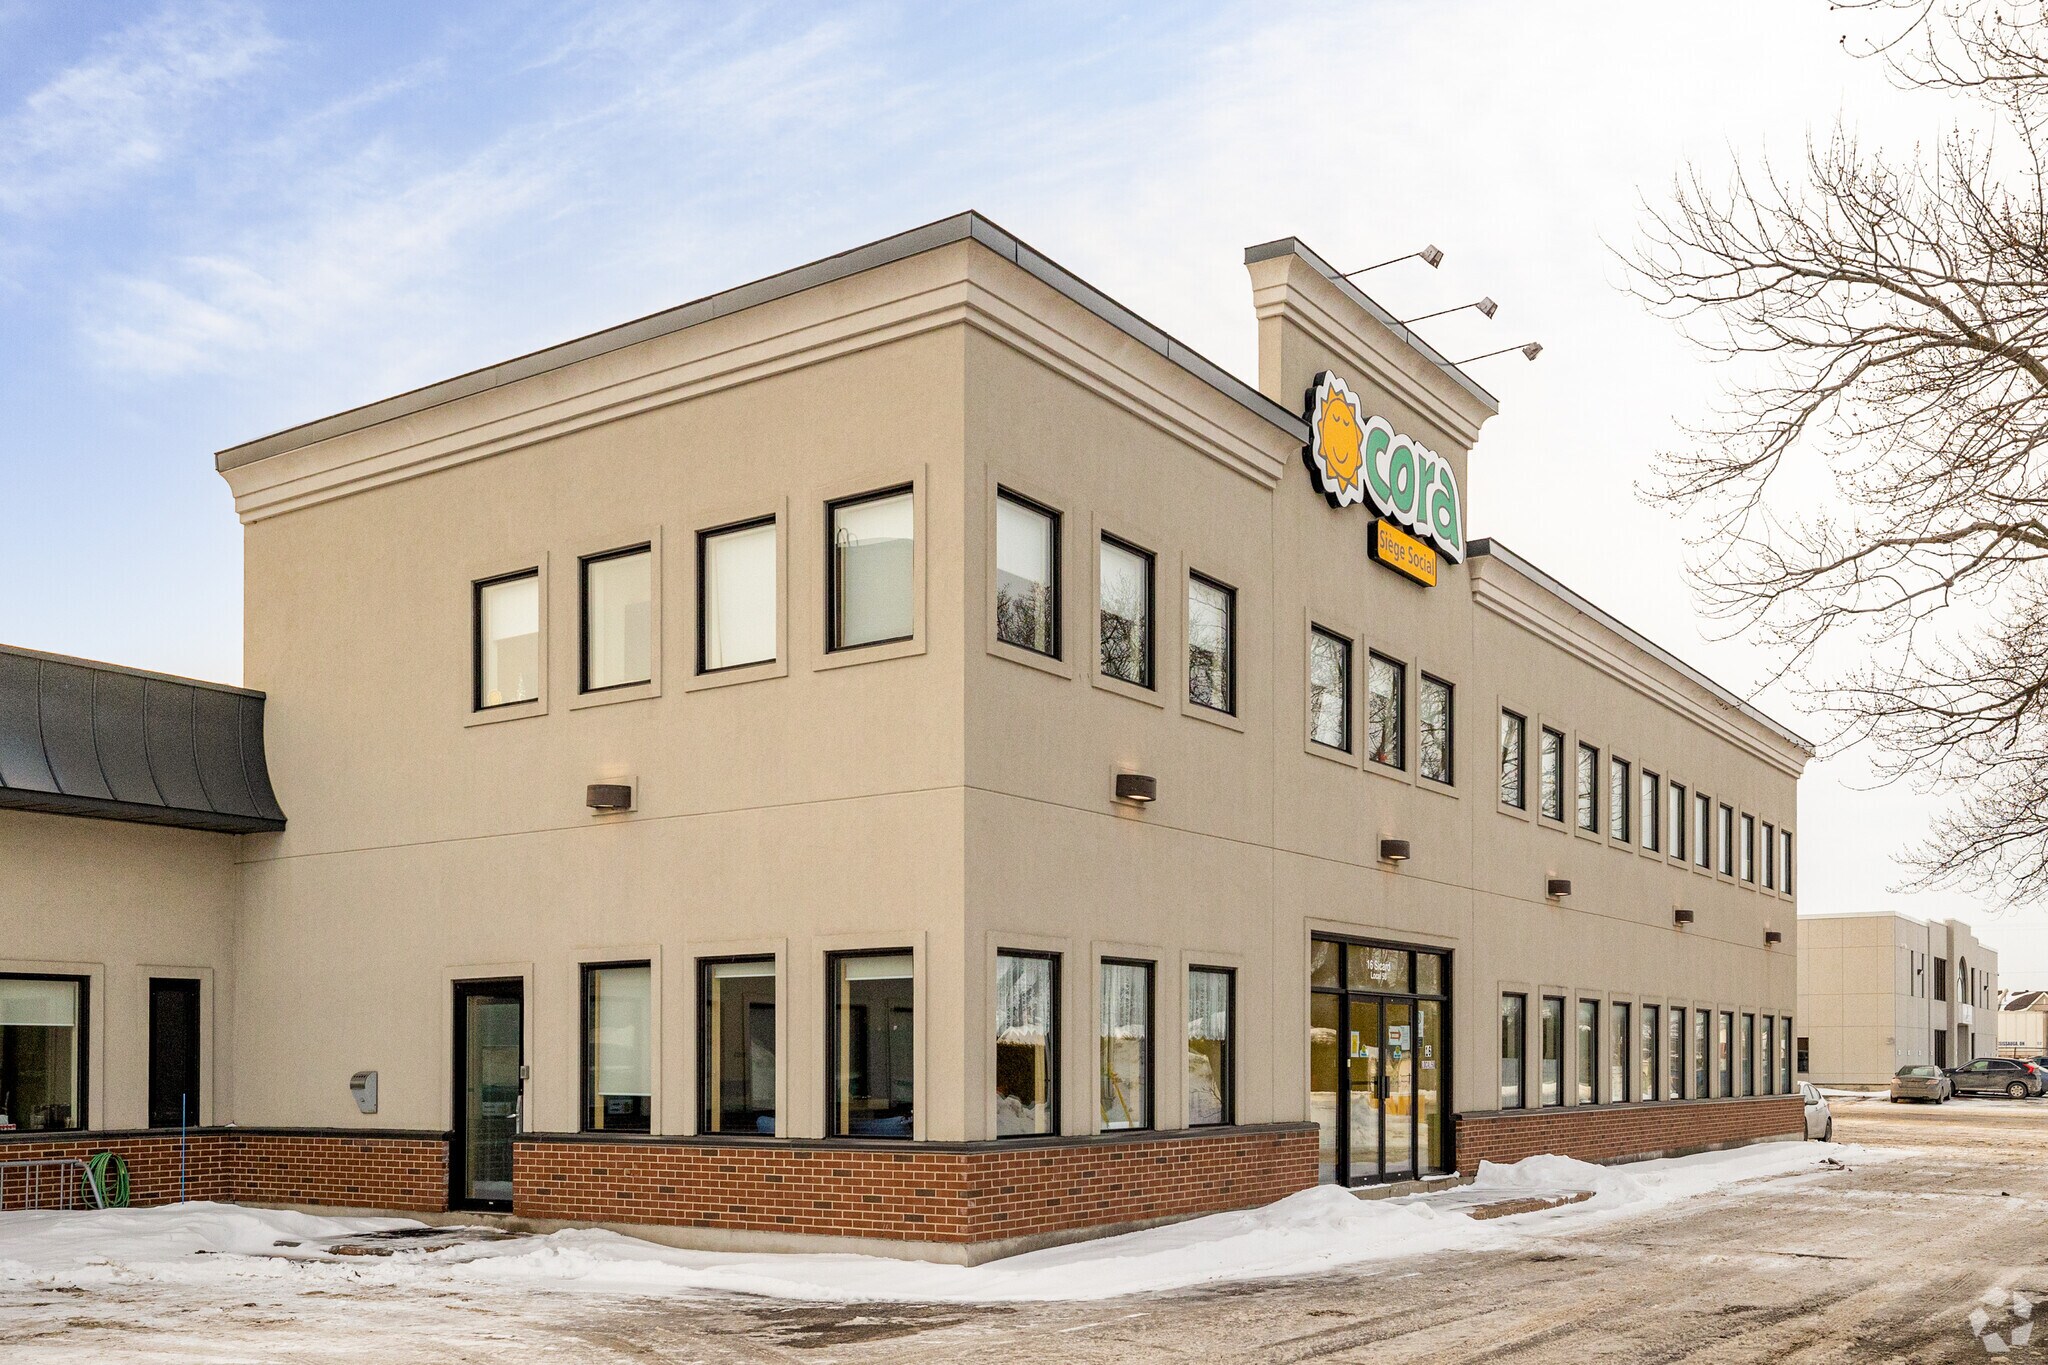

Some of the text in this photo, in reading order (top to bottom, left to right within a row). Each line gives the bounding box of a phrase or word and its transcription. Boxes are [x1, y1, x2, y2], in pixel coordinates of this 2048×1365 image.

[1366, 427, 1460, 551] cora
[1380, 530, 1435, 576] Siège Social
[1366, 959, 1392, 972] 16 Sicard
[1370, 971, 1382, 980] Local
